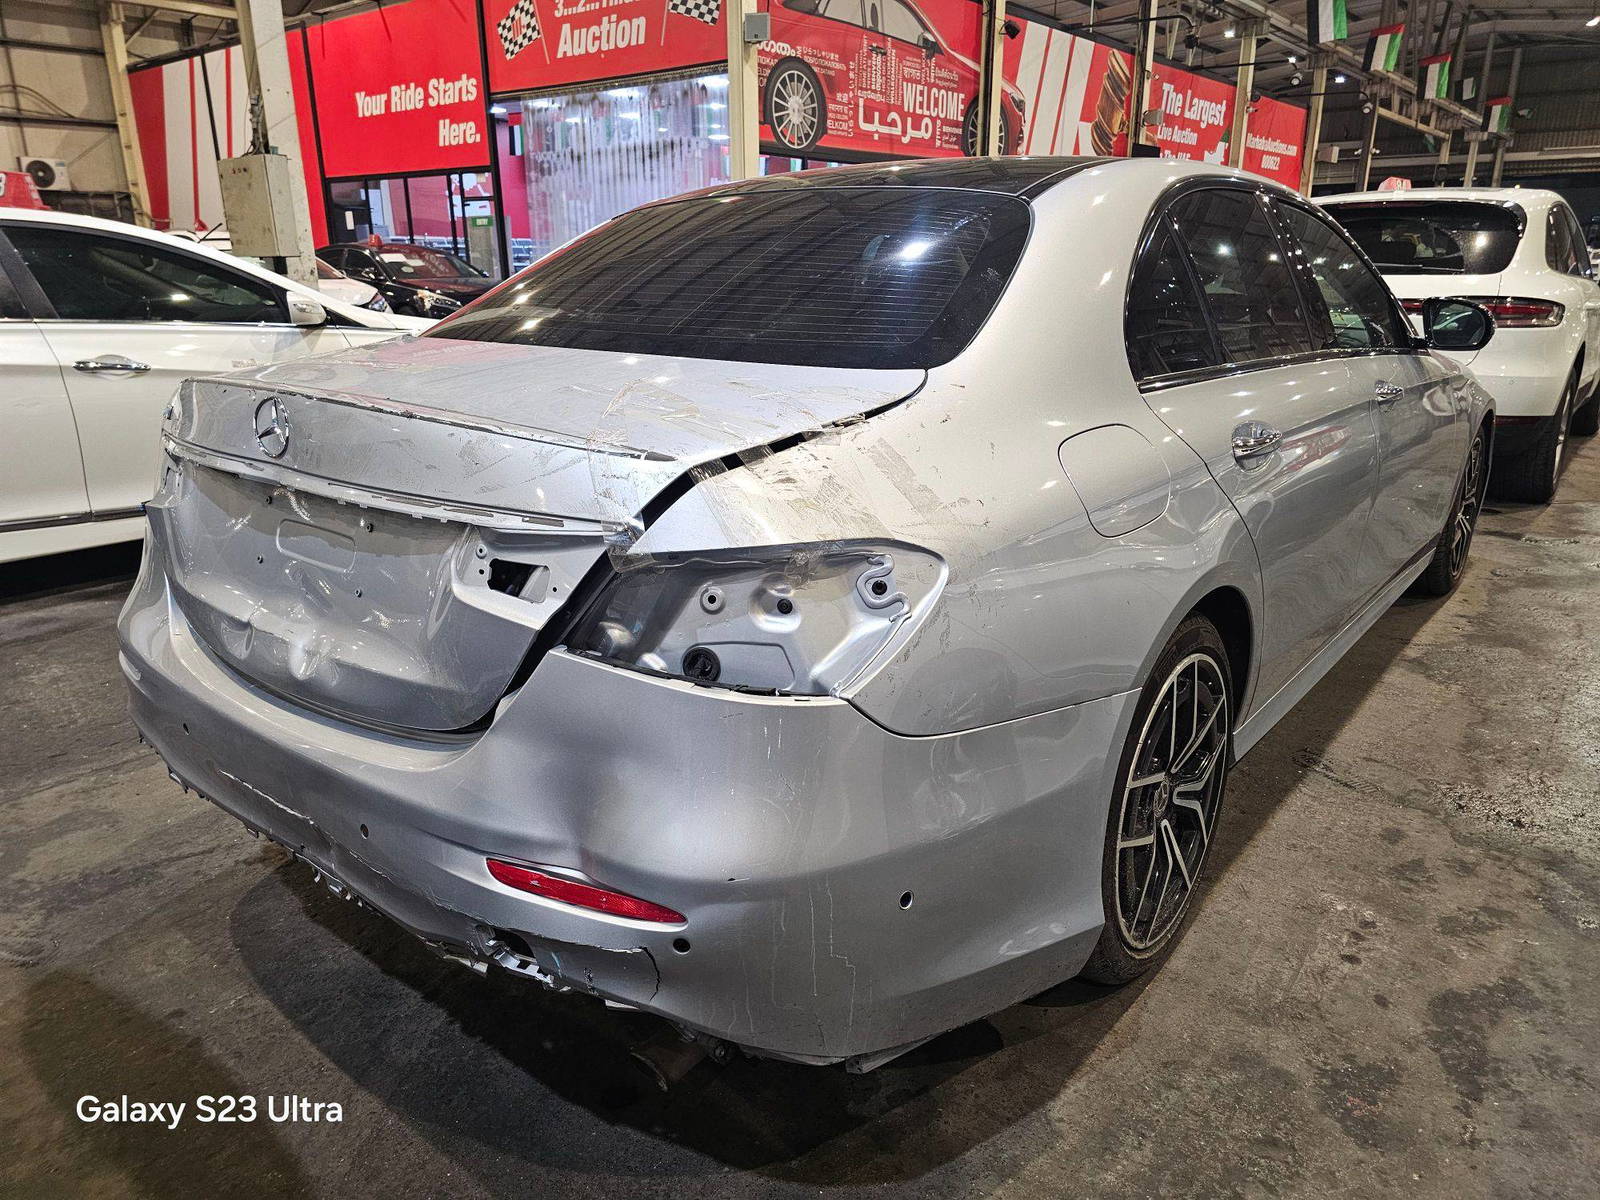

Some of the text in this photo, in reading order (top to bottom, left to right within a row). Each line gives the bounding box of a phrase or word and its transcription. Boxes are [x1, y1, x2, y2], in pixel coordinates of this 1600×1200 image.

[556, 14, 647, 59] Auction
[355, 73, 477, 118] Your Ride Starts
[902, 81, 966, 122] WELCOME
[1162, 82, 1227, 129] The Largest
[438, 118, 480, 147] Here.
[858, 97, 932, 144] مرحبا
[1157, 123, 1198, 146] Live Auction
